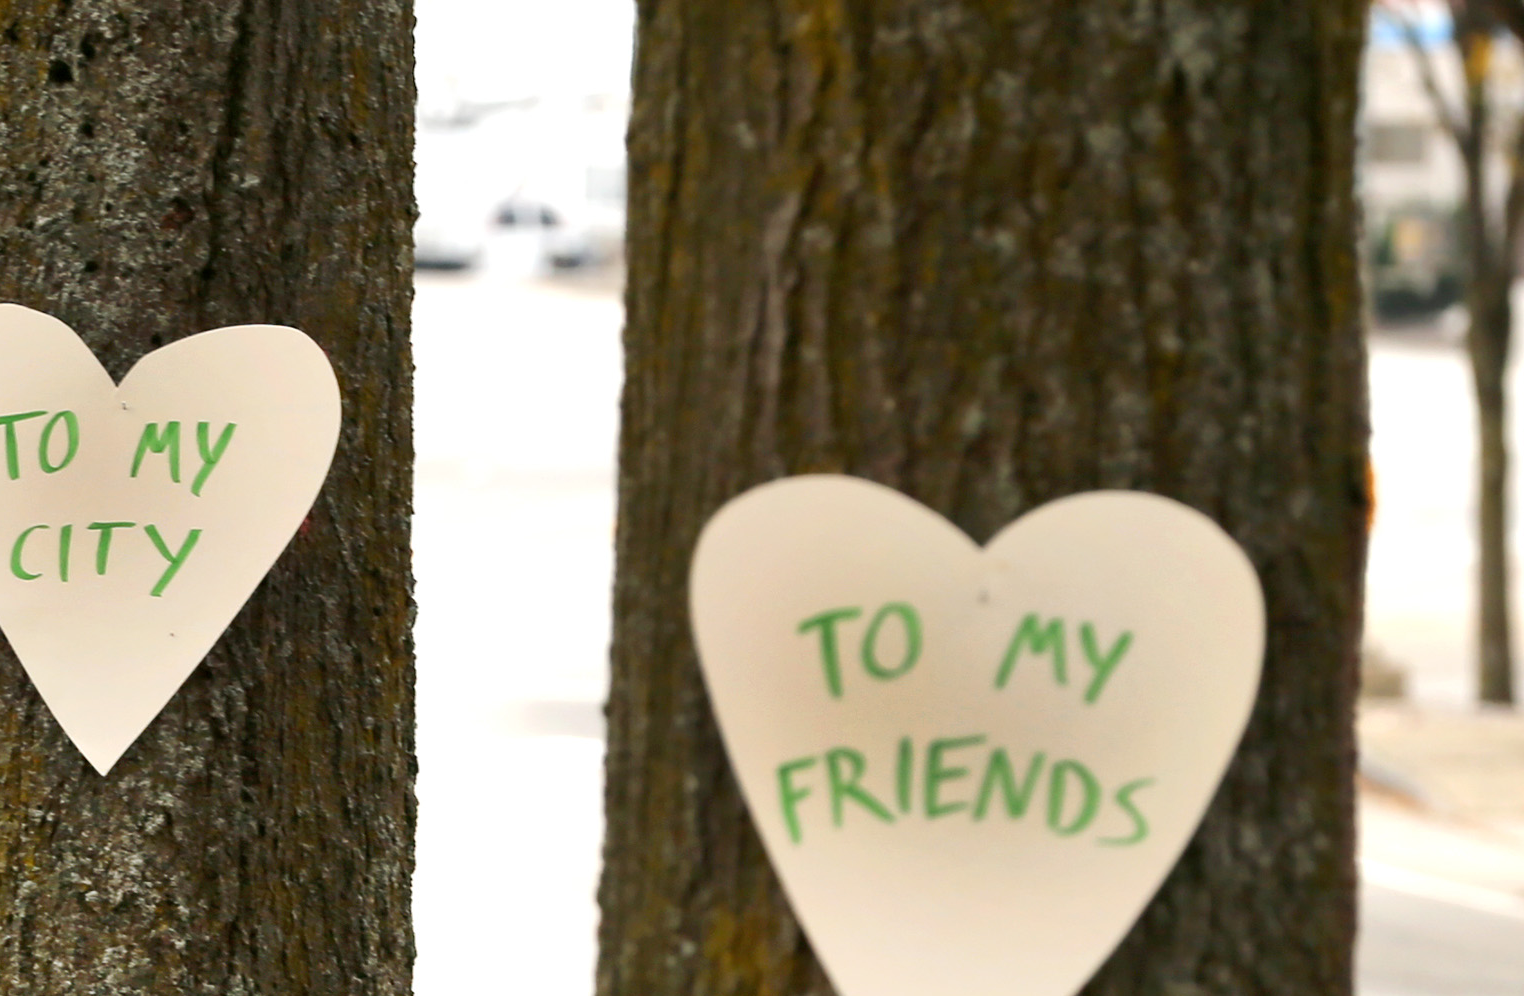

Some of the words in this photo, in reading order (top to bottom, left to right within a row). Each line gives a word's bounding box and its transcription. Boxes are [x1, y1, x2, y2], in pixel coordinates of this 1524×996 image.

[130, 421, 237, 497] MY
[10, 522, 203, 597] CITY
[797, 601, 923, 699] TO
[994, 612, 1133, 705] MY
[777, 735, 1156, 847] FRIENDS
